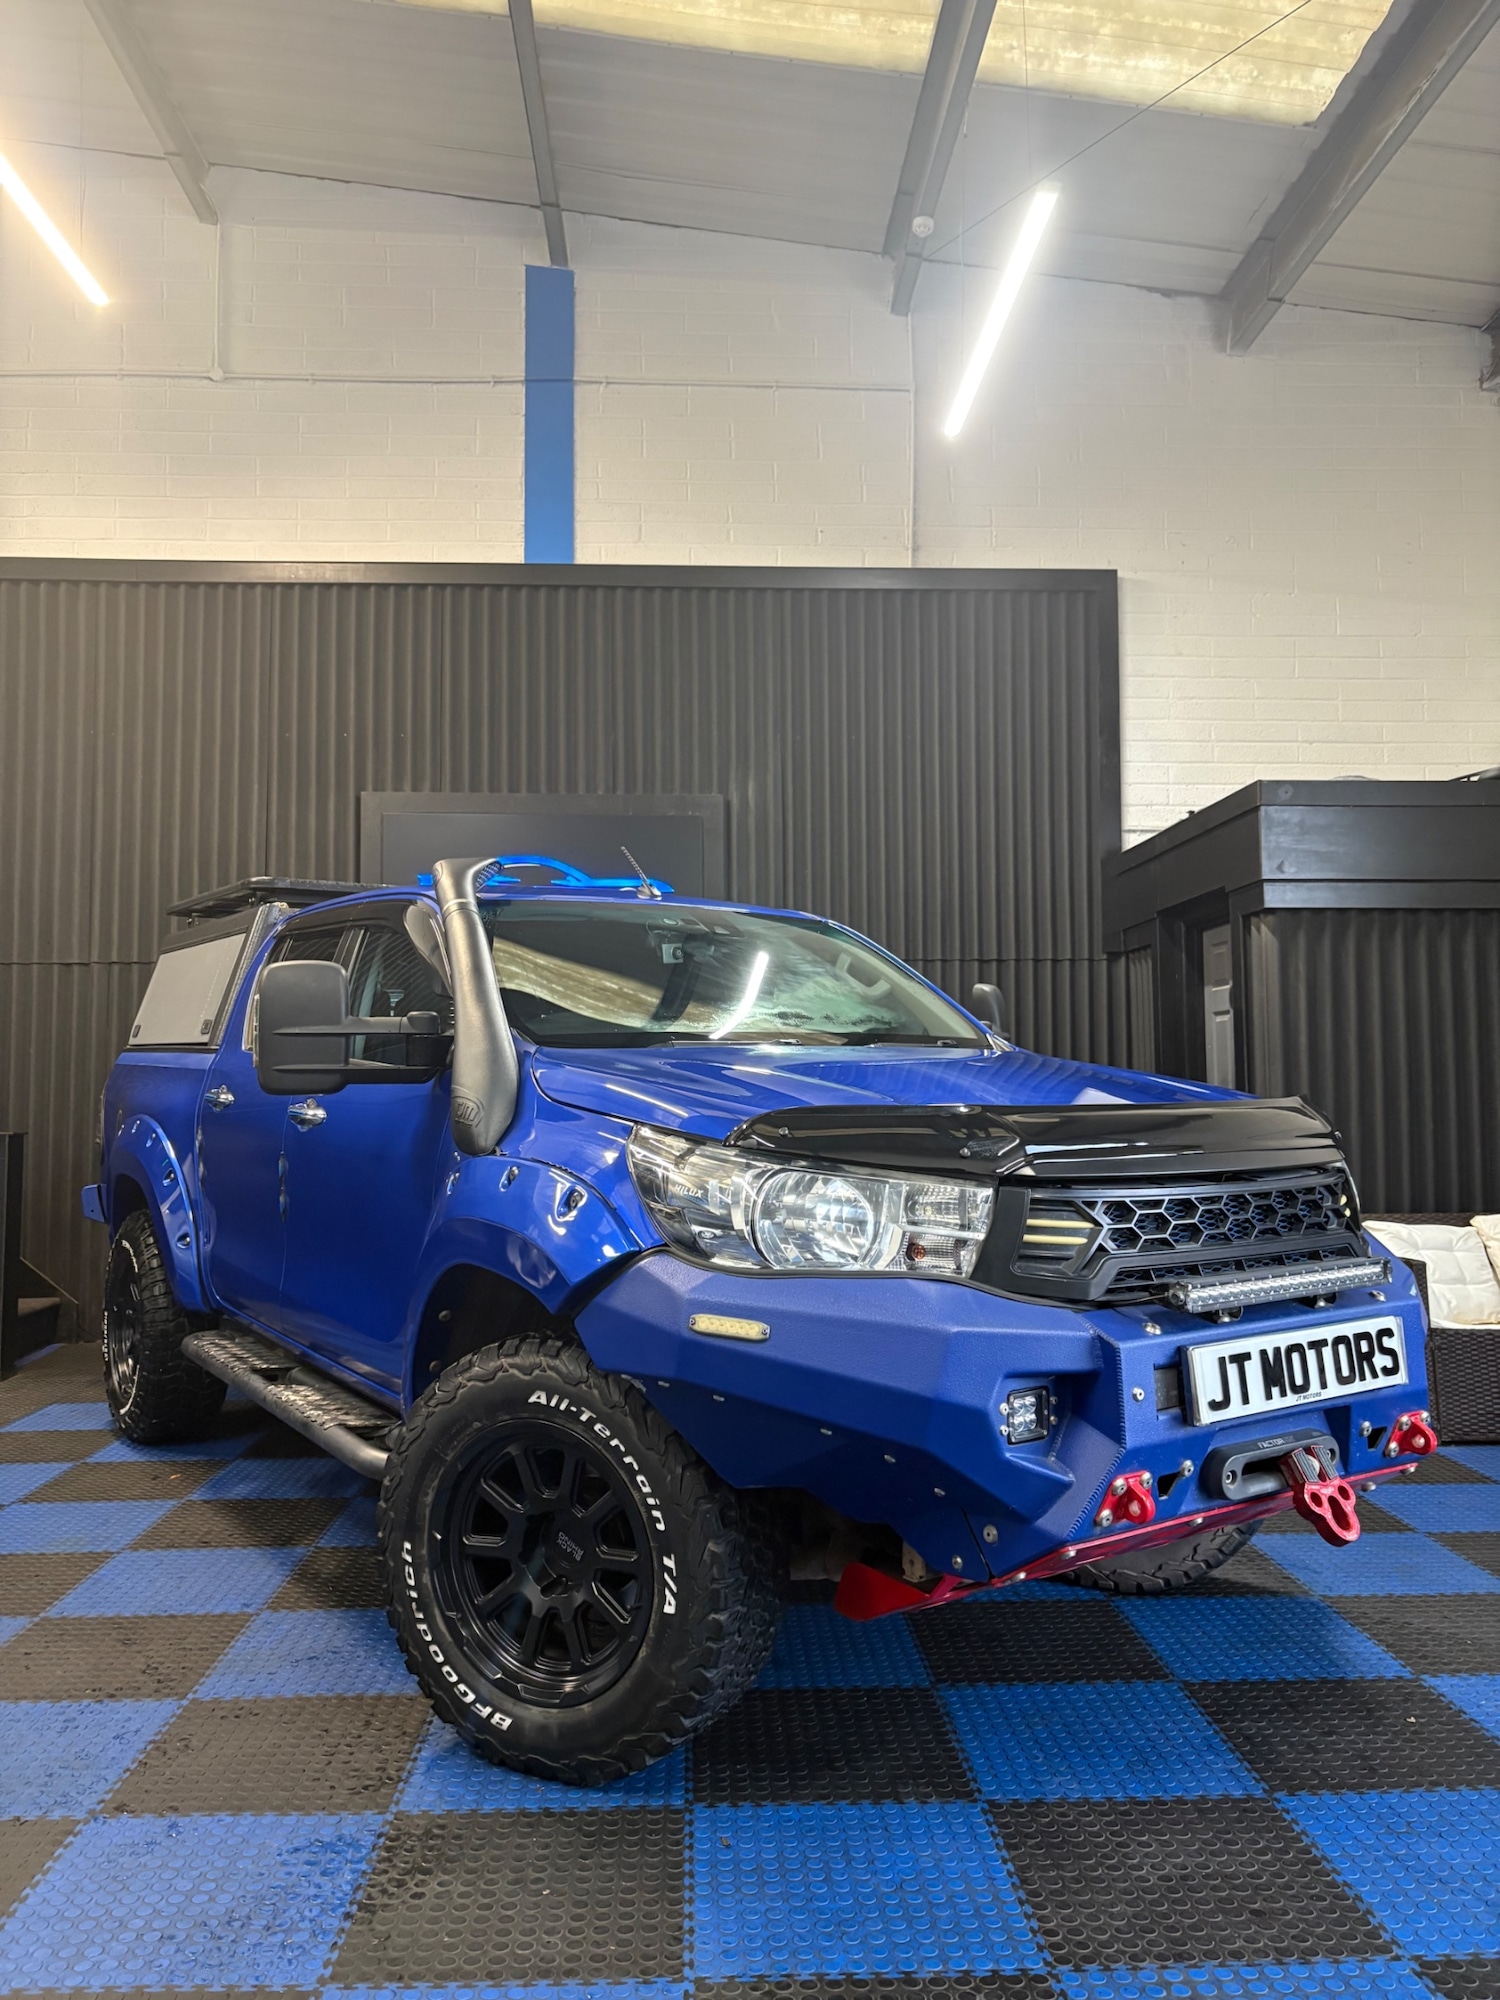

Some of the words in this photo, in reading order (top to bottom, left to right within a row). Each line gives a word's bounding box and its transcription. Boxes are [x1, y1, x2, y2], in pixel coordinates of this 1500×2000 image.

[674, 1184, 704, 1198] HILUX
[1208, 1351, 1252, 1411] JT
[1260, 1327, 1400, 1401] MOTORS
[1302, 1391, 1322, 1400] MOTORS
[527, 1390, 666, 1532] All-Terrain
[659, 1552, 677, 1615] T/A
[401, 1540, 513, 1733] BFGoodrich
